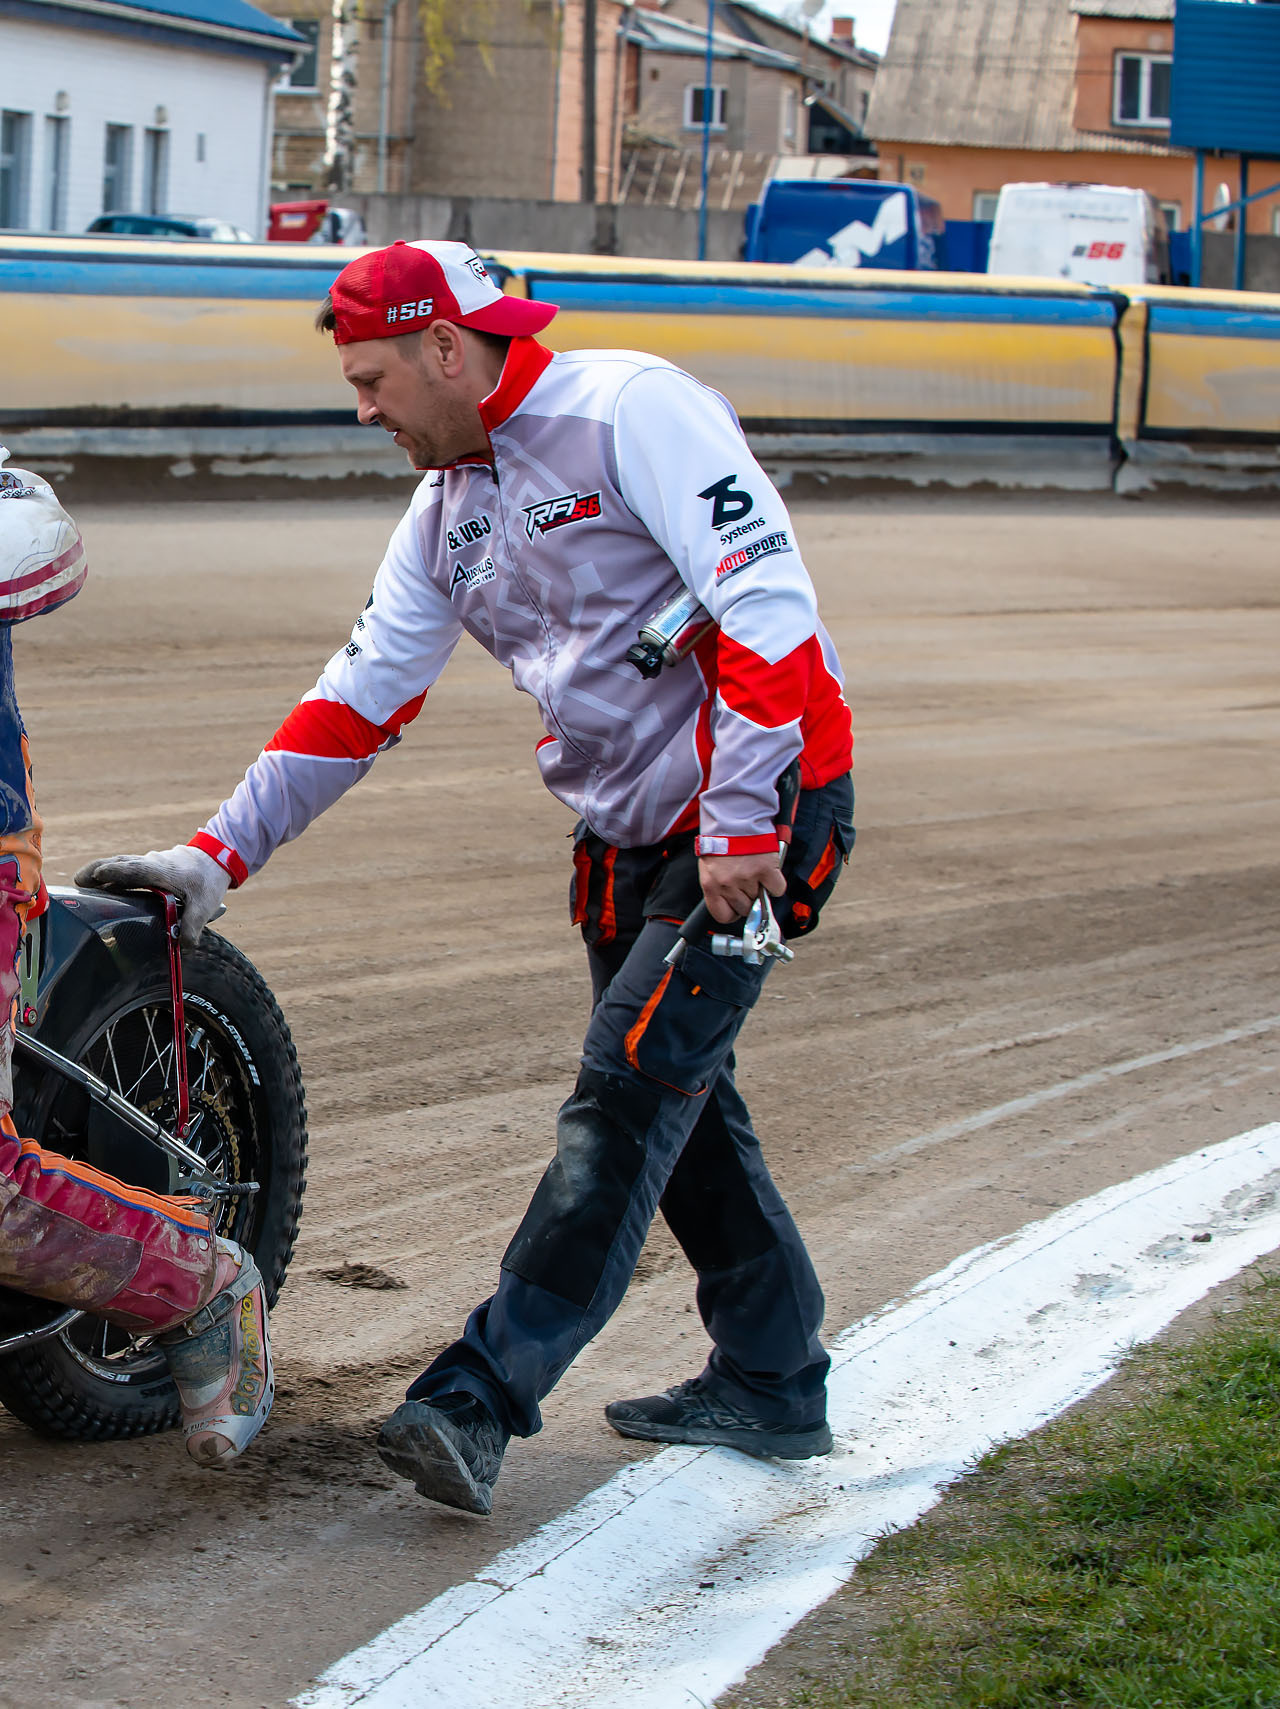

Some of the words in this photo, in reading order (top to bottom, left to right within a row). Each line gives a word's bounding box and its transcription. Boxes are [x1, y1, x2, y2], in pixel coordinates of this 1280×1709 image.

[387, 298, 434, 323] #56
[720, 516, 766, 546] systems
[716, 533, 788, 578] MOTOSPORTS
[218, 1014, 253, 1062] PLATINUM
